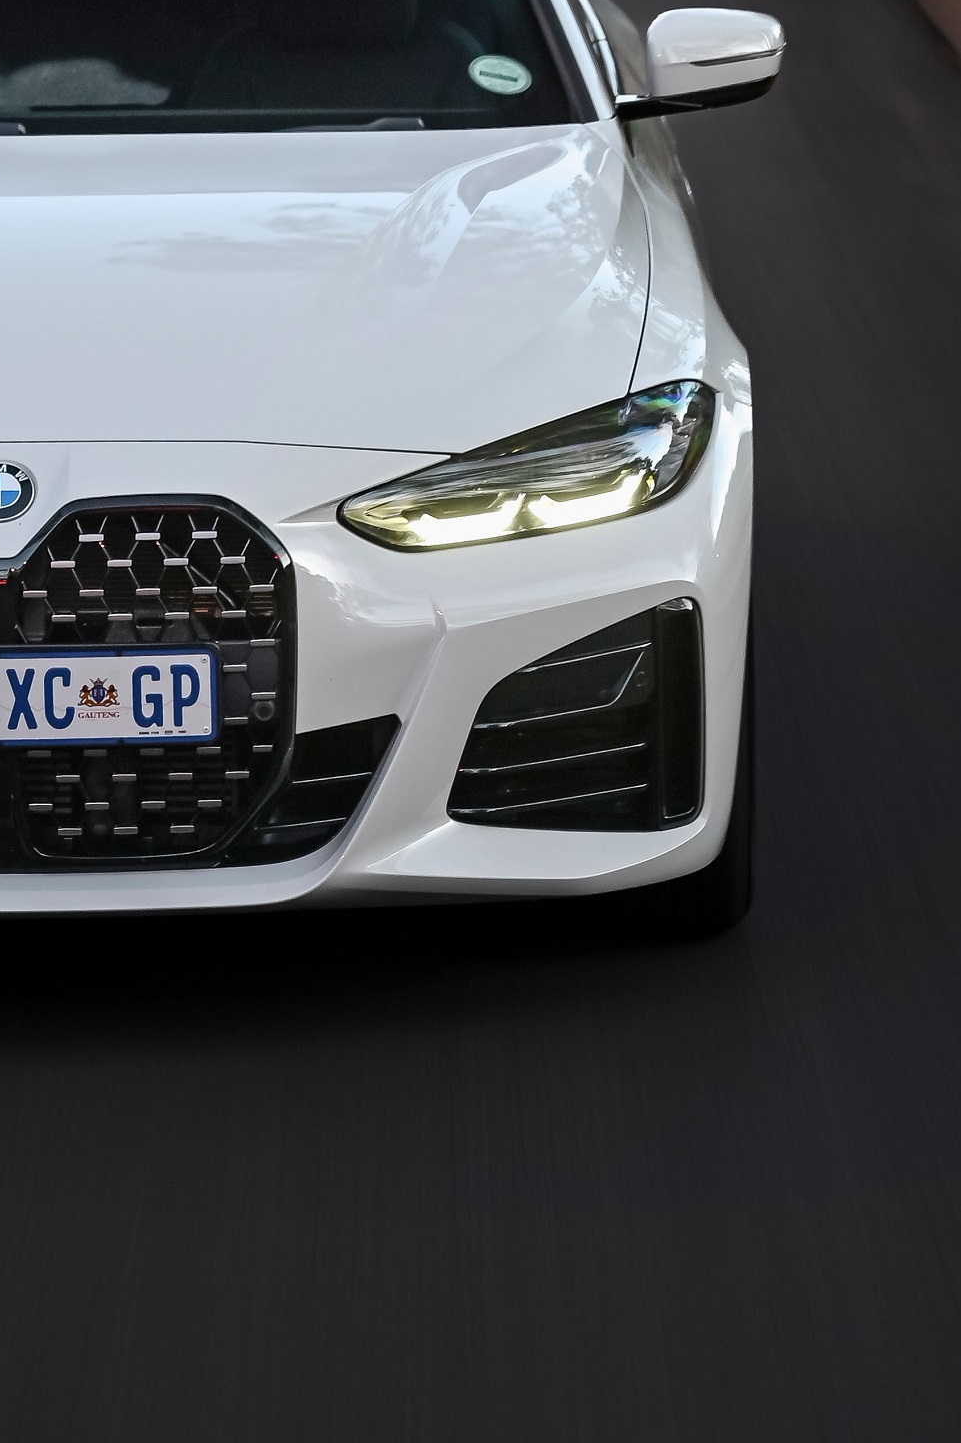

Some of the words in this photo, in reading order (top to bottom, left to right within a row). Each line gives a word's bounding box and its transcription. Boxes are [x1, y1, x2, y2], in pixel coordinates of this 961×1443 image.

[6, 667, 75, 730] XC
[131, 665, 201, 727] GP
[77, 711, 120, 719] GAUTENG
